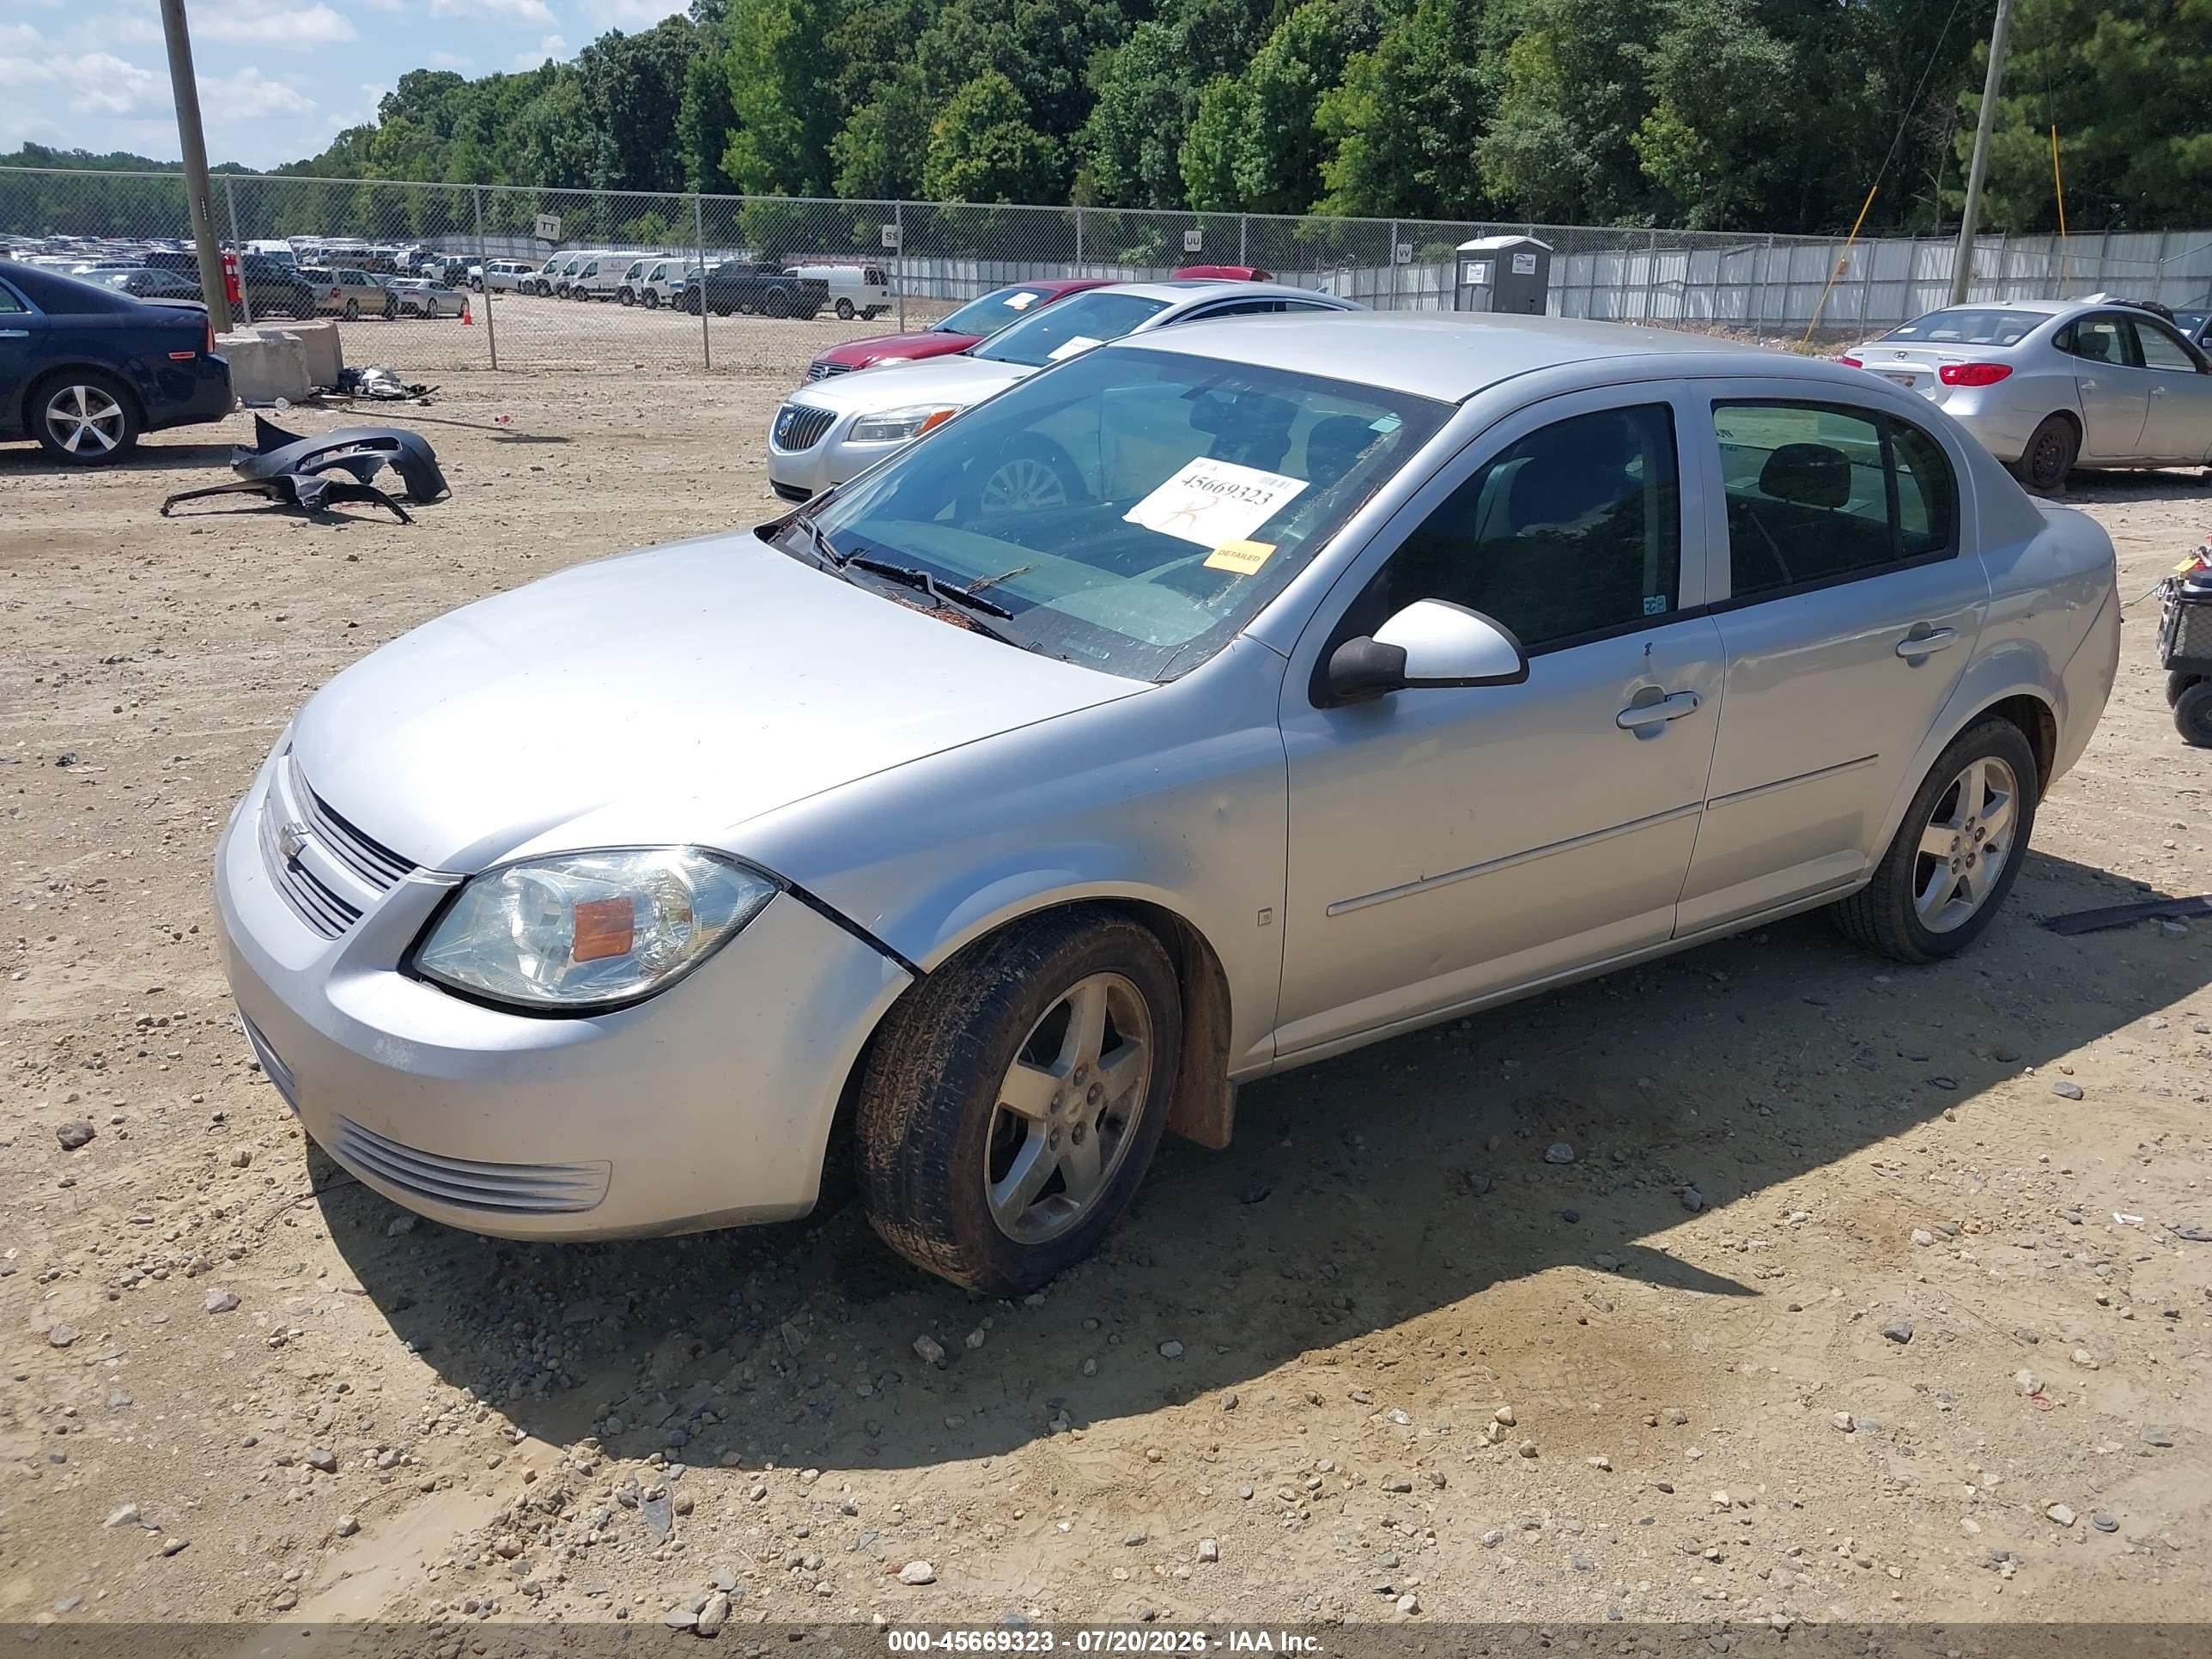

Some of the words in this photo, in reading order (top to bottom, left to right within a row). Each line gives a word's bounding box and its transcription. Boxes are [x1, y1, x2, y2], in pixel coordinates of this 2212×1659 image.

[541, 221, 556, 232] TT
[1186, 237, 1200, 246] UU
[1181, 475, 1273, 506] 45669323
[1217, 550, 1261, 562] DETAILED
